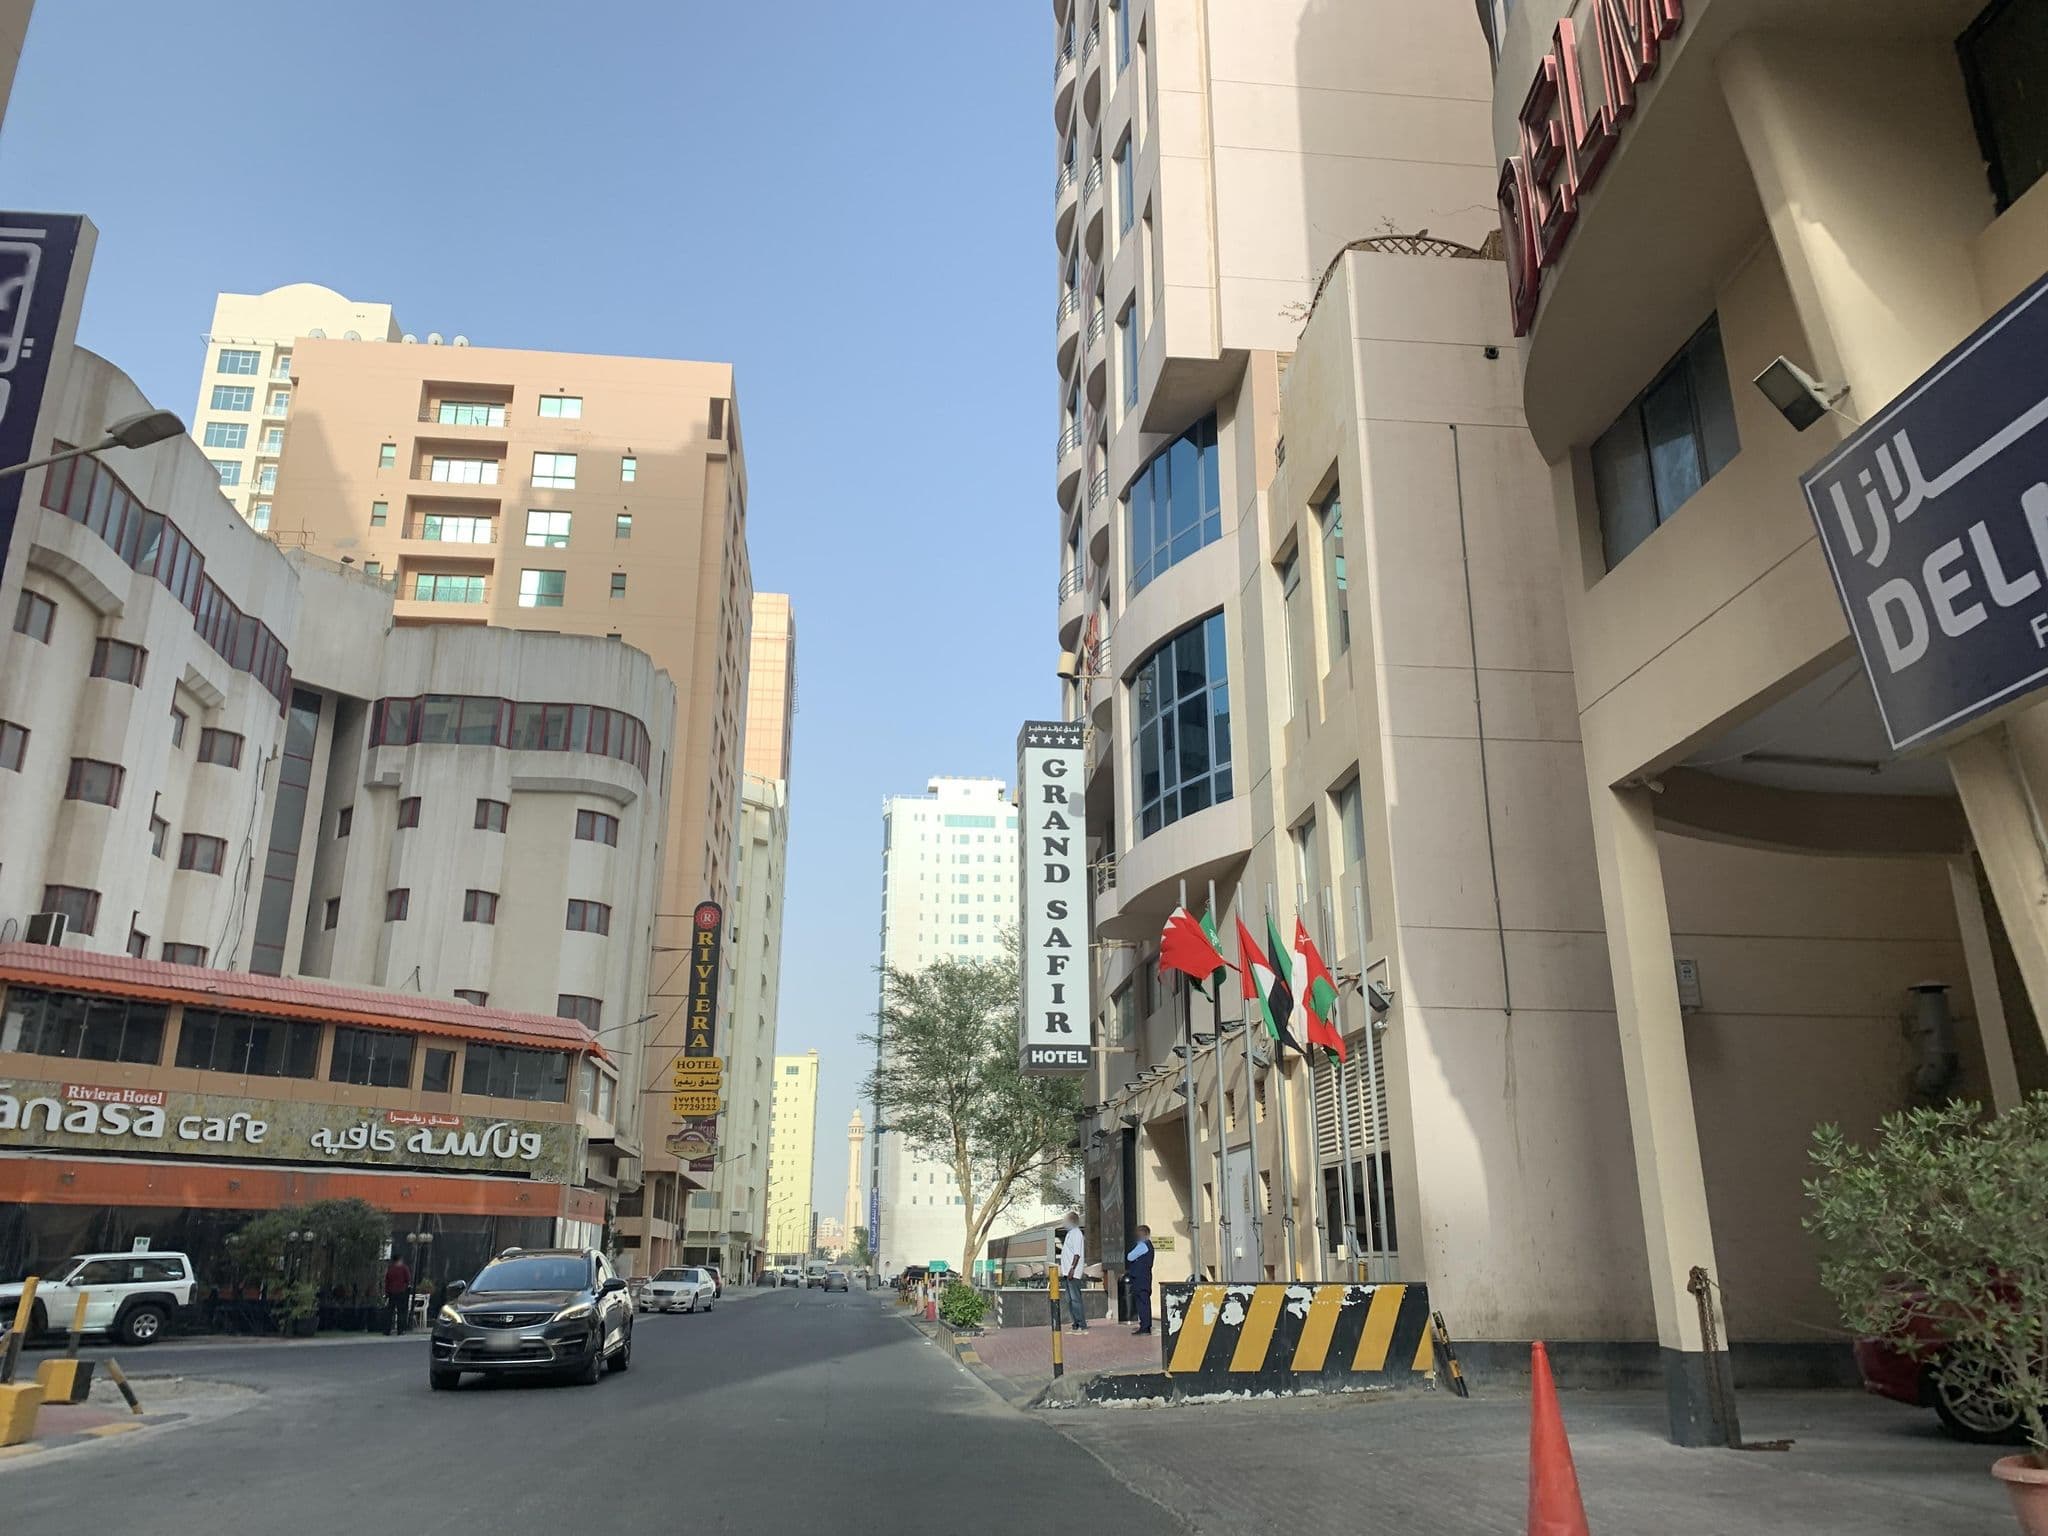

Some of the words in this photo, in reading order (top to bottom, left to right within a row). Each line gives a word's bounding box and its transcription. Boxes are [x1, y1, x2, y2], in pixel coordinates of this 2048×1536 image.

[1042, 758, 1071, 884] GRAND
[1043, 899, 1072, 1034] SAFIR
[691, 931, 715, 1048] RIVIERA
[677, 1060, 719, 1069] HOTEL
[1031, 1050, 1088, 1064] HOTEL
[66, 1085, 121, 1102] Riviera
[123, 1090, 162, 1105] Hotel
[673, 1103, 717, 1111] 17729222
[0, 1094, 165, 1139] anasa
[178, 1112, 268, 1144] cafe
